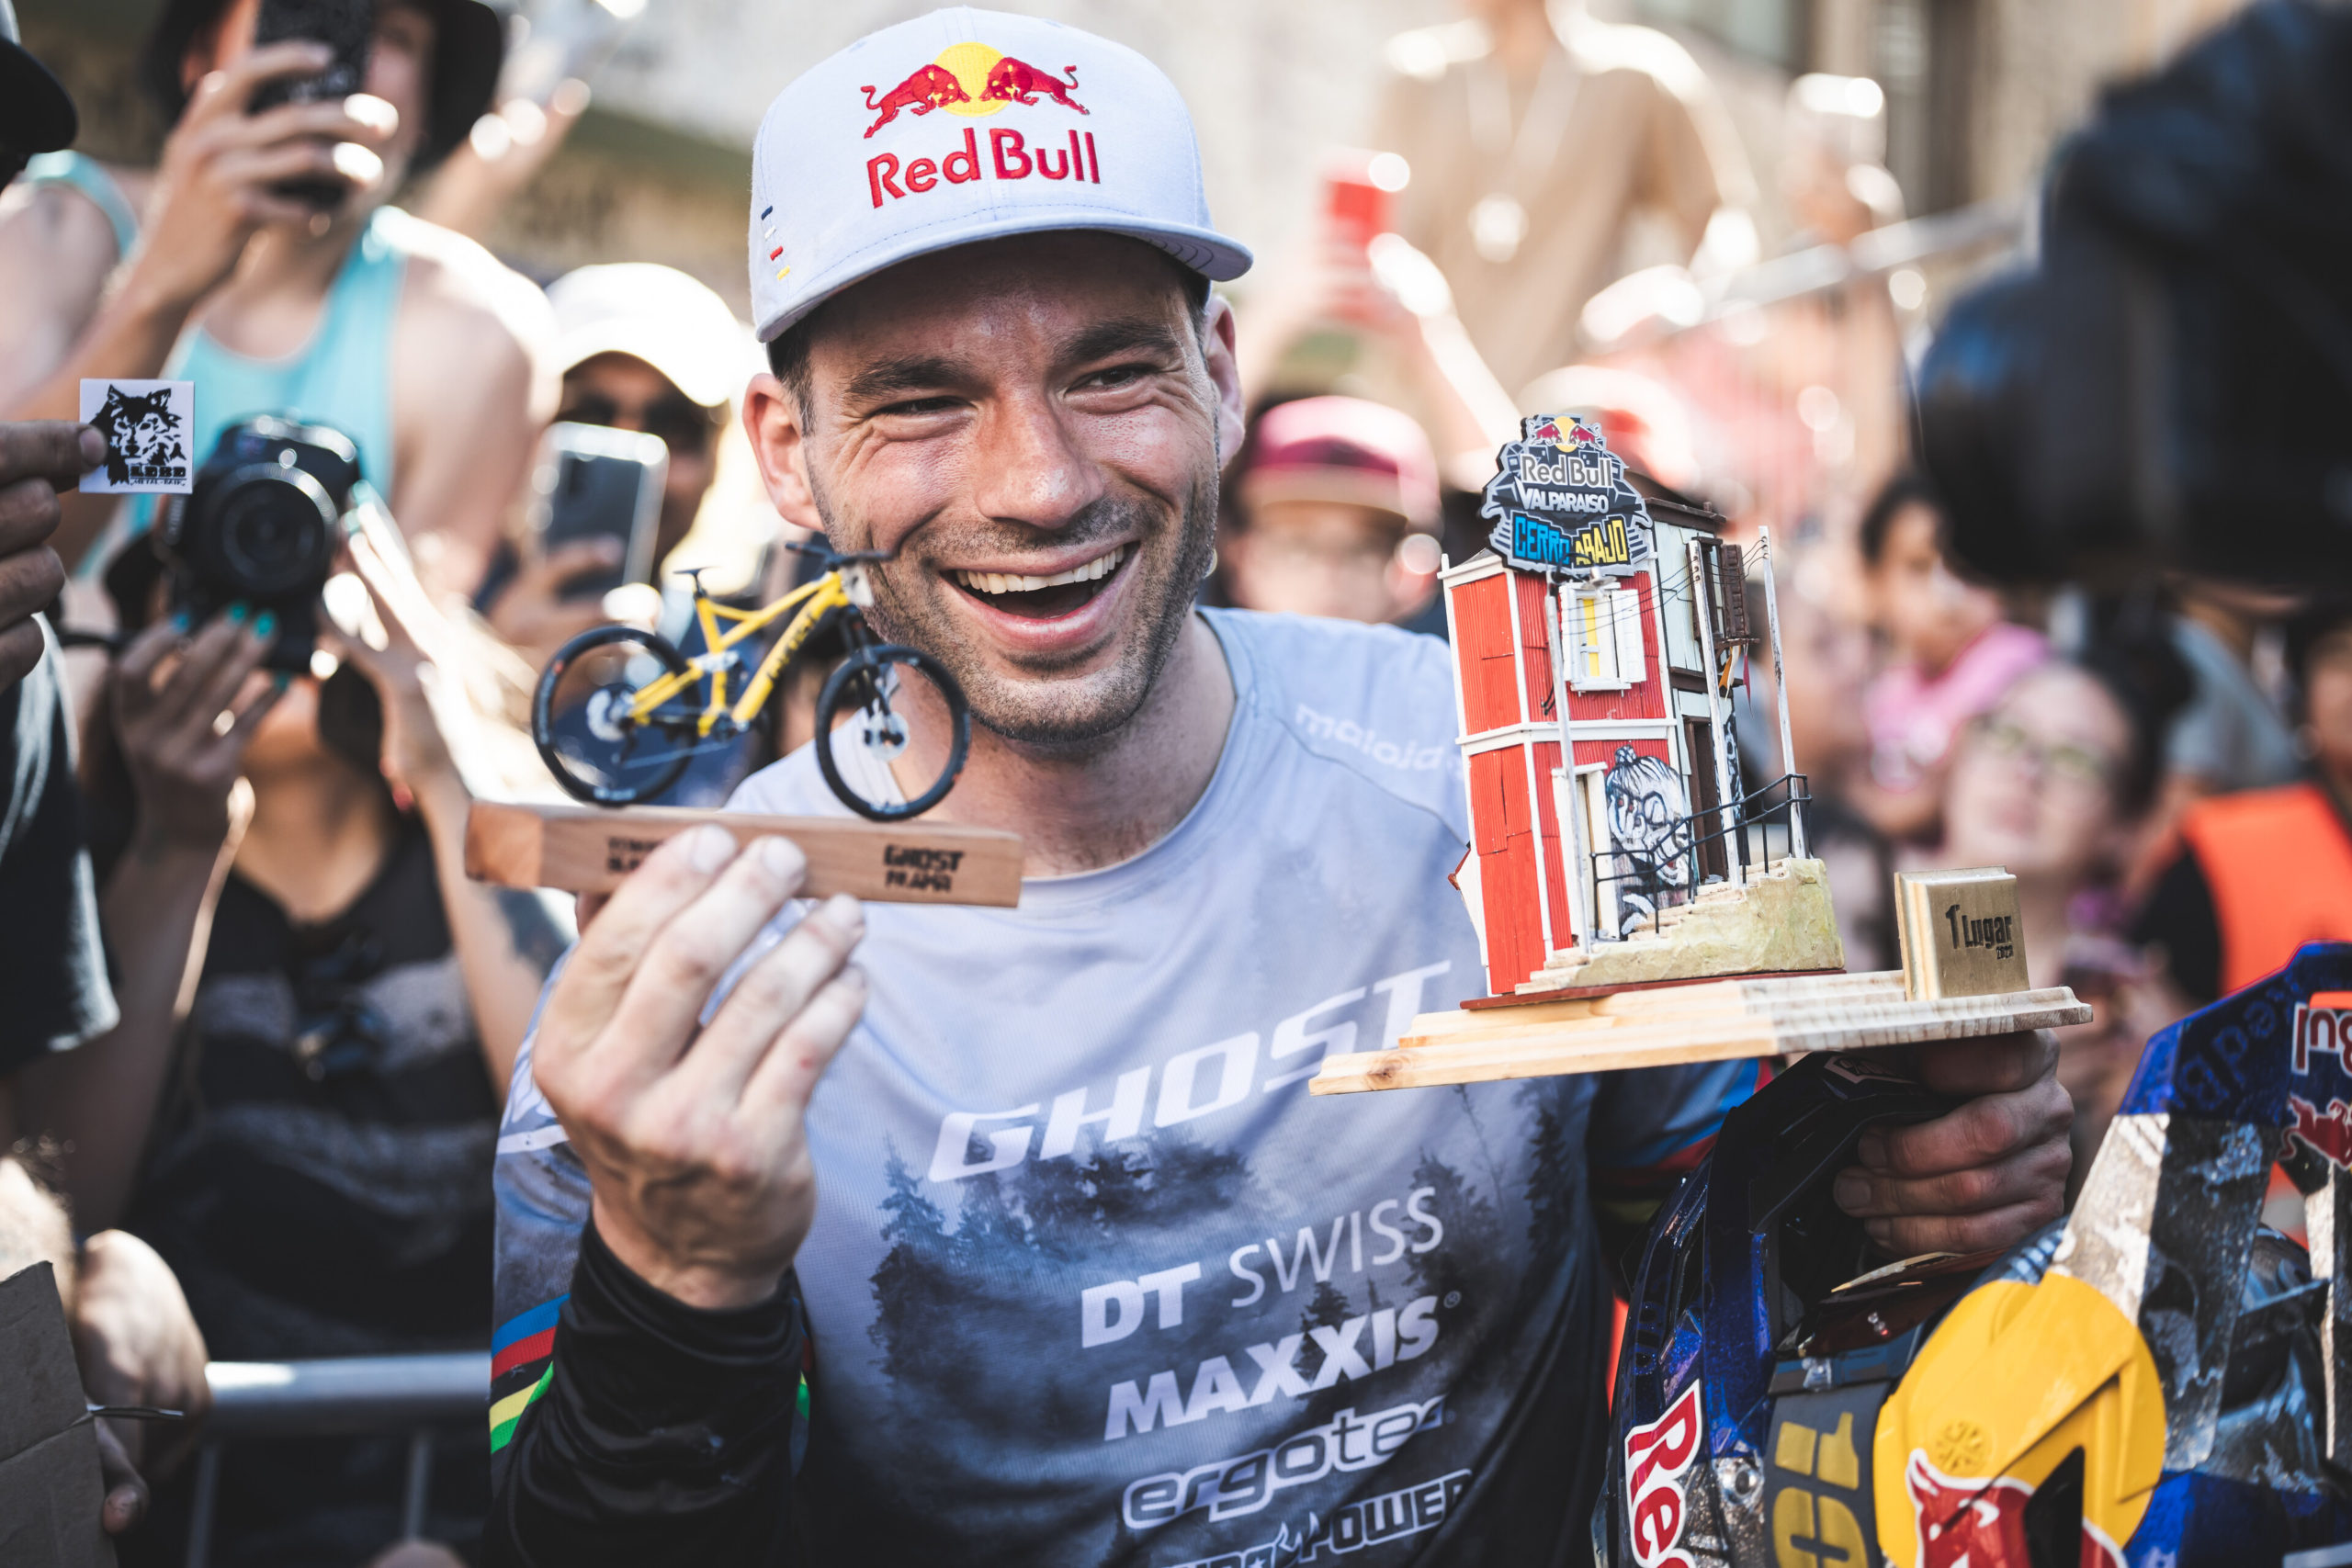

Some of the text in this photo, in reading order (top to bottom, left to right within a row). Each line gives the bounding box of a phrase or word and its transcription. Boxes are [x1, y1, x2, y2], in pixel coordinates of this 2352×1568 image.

[866, 128, 1101, 209] Red Bull
[1515, 477, 1609, 513] VALPARAISO
[1521, 454, 1613, 487] Red Bull
[1515, 515, 1628, 565] CERRO ABAJO
[884, 844, 966, 873] GHOST
[1962, 915, 2013, 950] Lugar
[928, 961, 1452, 1183] GHOST
[1081, 1188, 1444, 1348] DT SWISS
[1105, 1295, 1440, 1441] MAXXIS
[1625, 1380, 1697, 1568] Re
